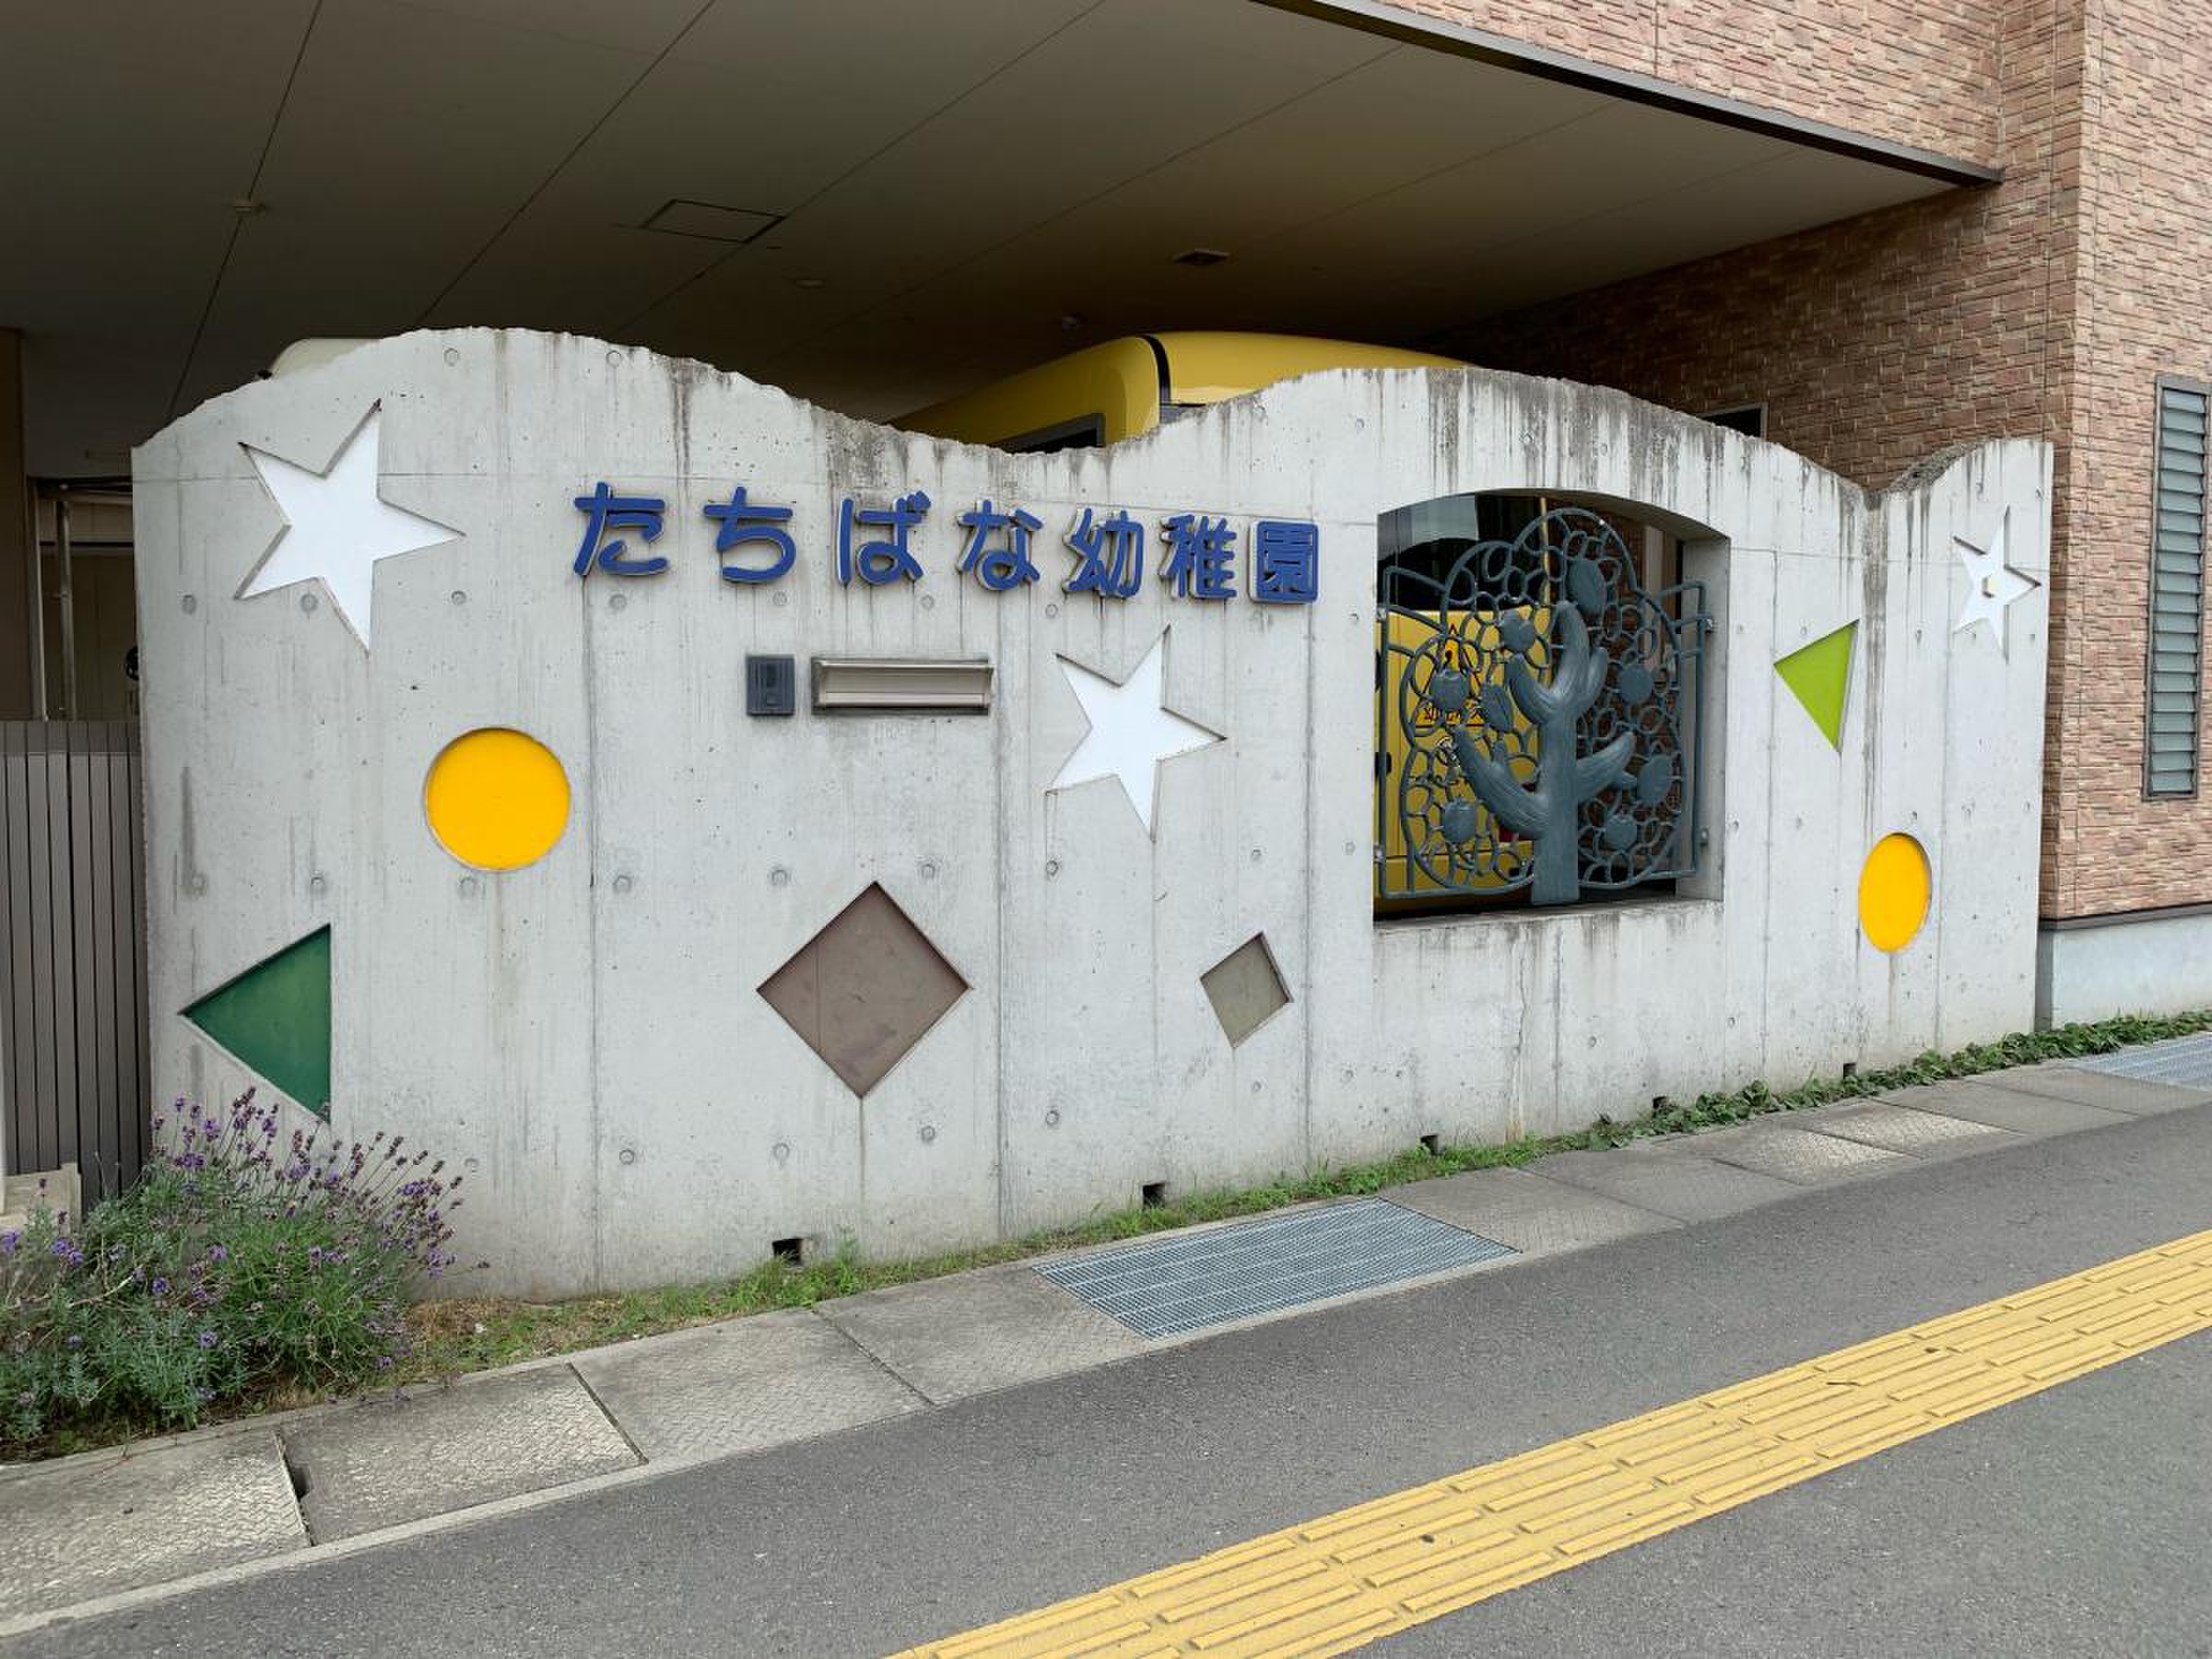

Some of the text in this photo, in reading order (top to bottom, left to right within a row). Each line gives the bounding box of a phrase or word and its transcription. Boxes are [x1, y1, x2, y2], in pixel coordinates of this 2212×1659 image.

[573, 481, 1320, 603] たちばな幼稚園
